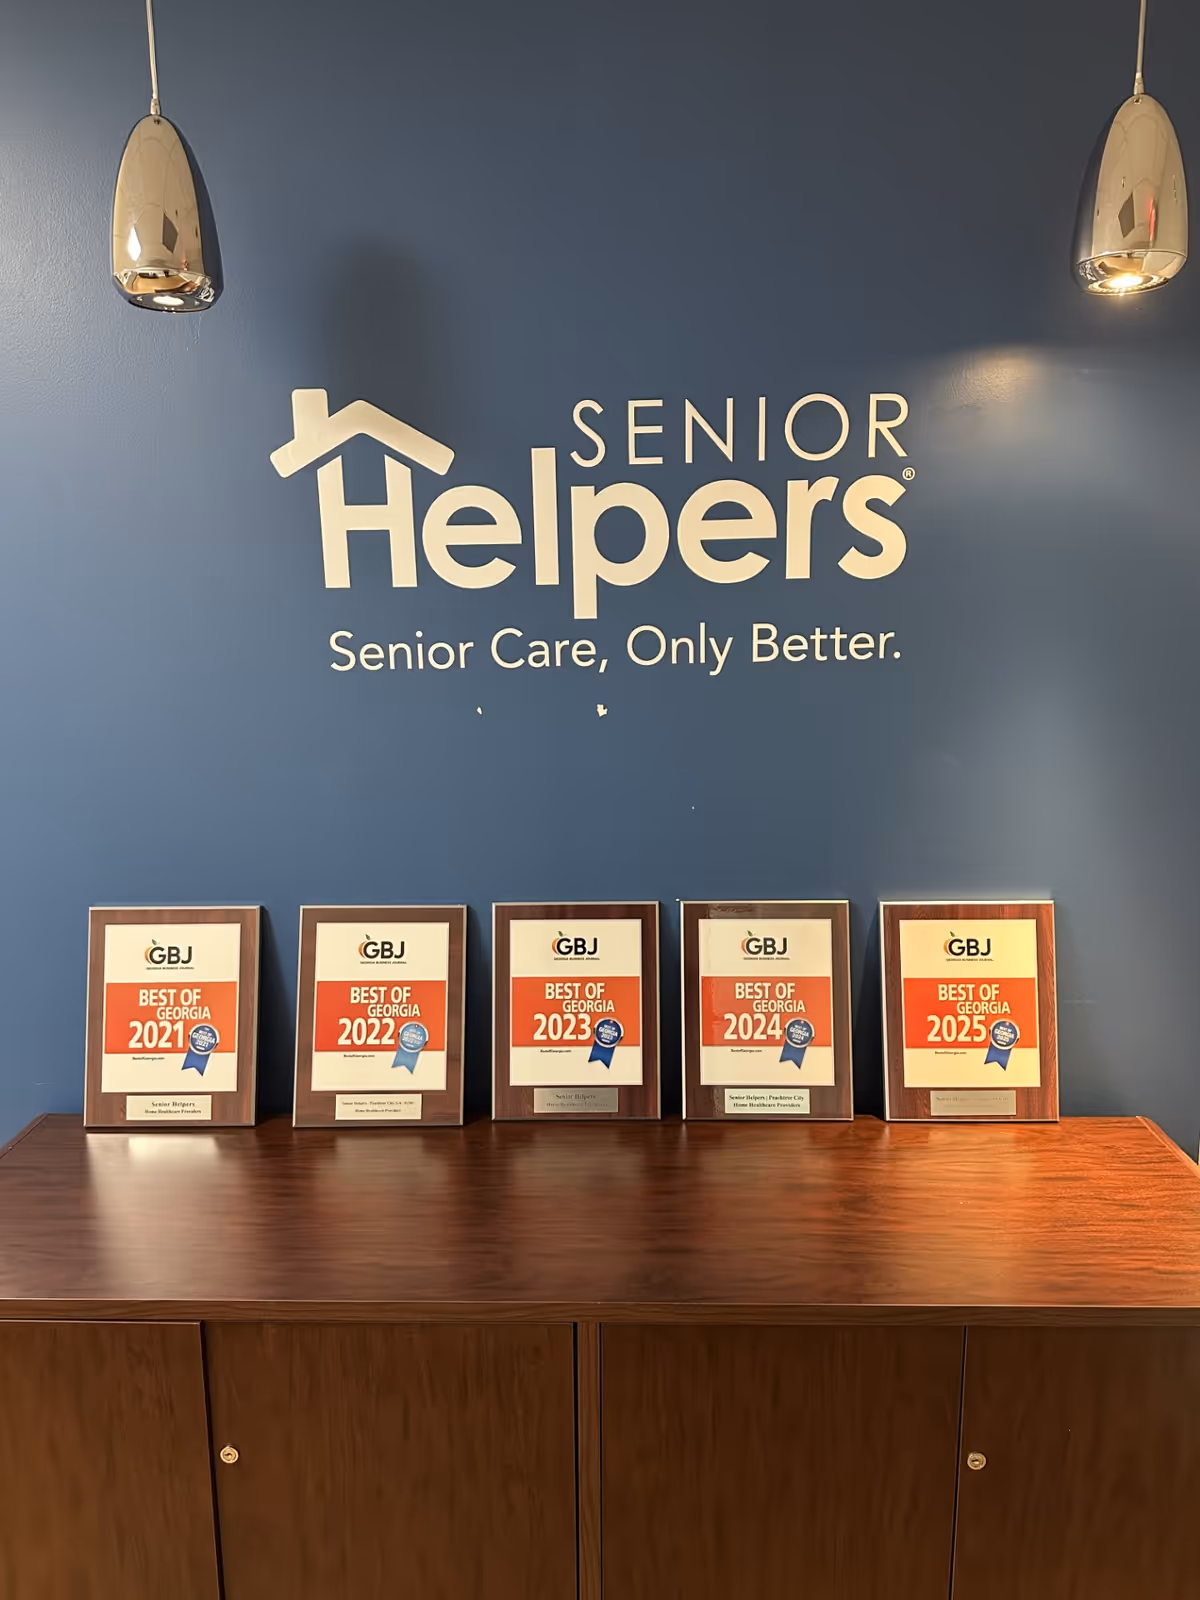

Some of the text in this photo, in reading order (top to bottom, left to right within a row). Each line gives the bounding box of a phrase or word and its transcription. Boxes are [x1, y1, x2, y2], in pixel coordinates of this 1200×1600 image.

[570, 393, 910, 468] SENIOR
[329, 622, 901, 676] Senior Care, Only Better.
[363, 941, 405, 959] GBJ
[556, 937, 598, 955] GBJ
[746, 937, 787, 955] GBJ
[948, 938, 991, 956] GBJ
[149, 946, 192, 965] GBJ
[139, 988, 202, 1007] BEST OF
[350, 986, 412, 1004] BEST OF
[545, 982, 605, 1000] BEST OF
[734, 982, 796, 1000] BEST OF
[937, 983, 1000, 1001] BEST OF
[157, 1006, 212, 1021] GEORGIA
[367, 1003, 421, 1018] GEORGIA
[562, 999, 615, 1013] GEORGIA
[752, 999, 807, 1013] GEORGIA
[956, 1001, 1012, 1015] GEORGIA
[128, 1020, 184, 1049] 2021
[337, 1017, 396, 1046] 2022
[533, 1012, 592, 1041] 2023
[723, 1012, 784, 1041] 2024
[927, 1014, 987, 1043] 2025
